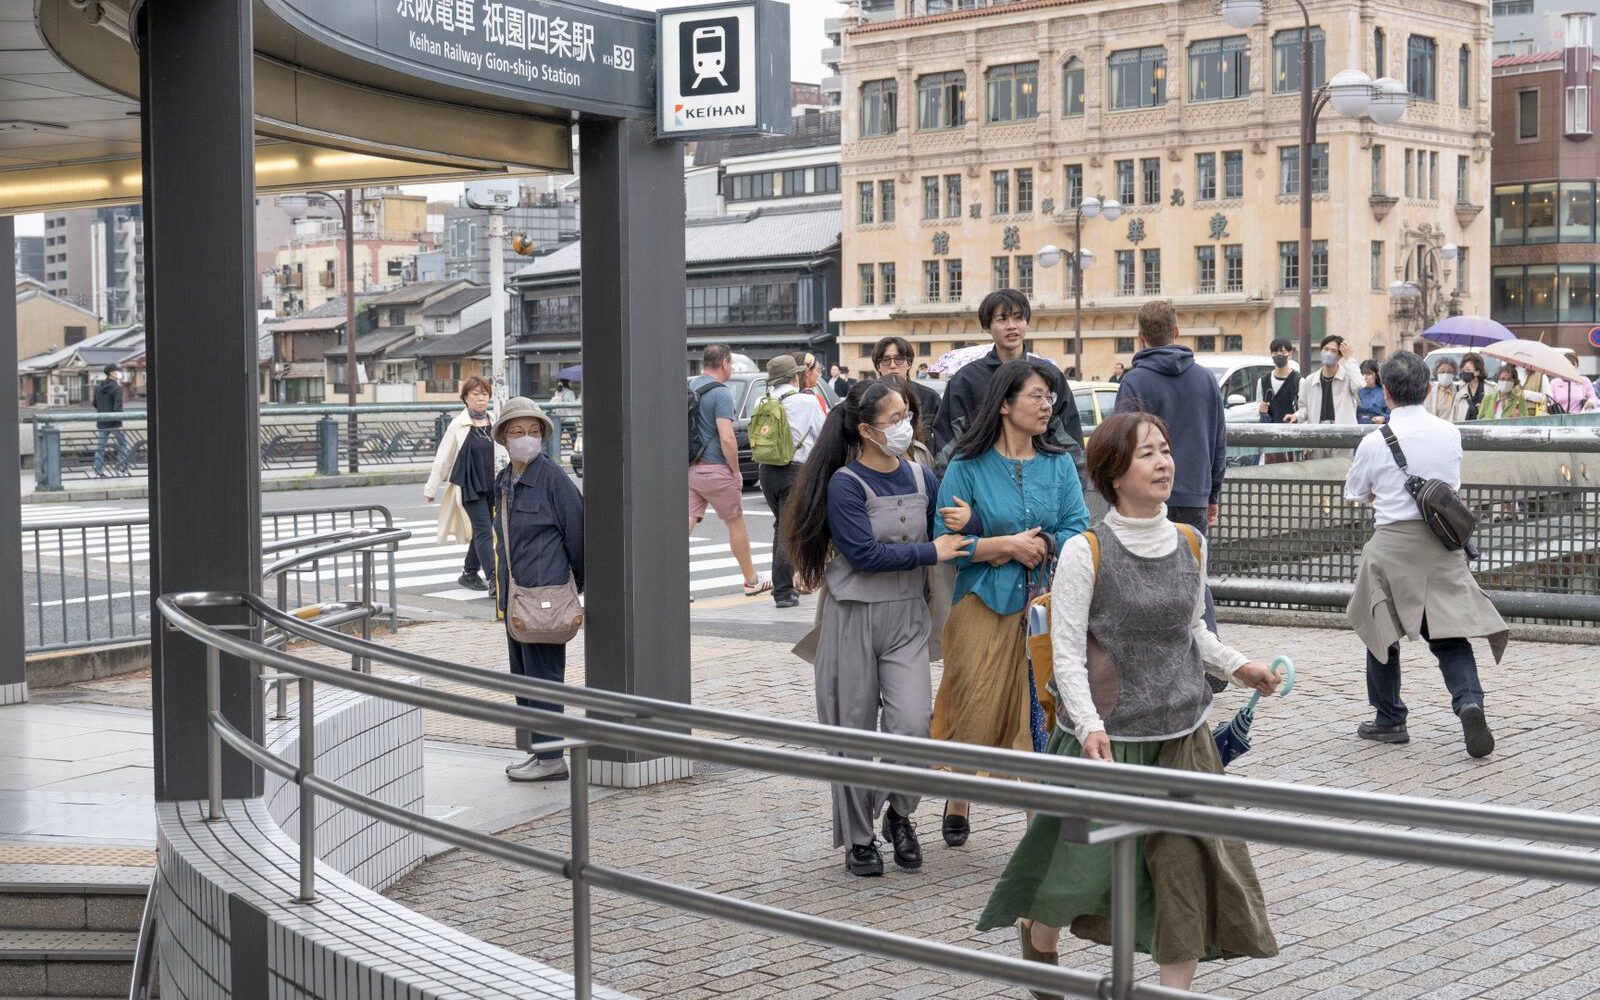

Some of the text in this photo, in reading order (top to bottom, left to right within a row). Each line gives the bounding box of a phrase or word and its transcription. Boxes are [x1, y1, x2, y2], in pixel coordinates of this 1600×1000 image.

[409, 30, 581, 86] Keihan Railway Gion-shijo Station
[482, 0, 595, 63] 祇園四条駅
